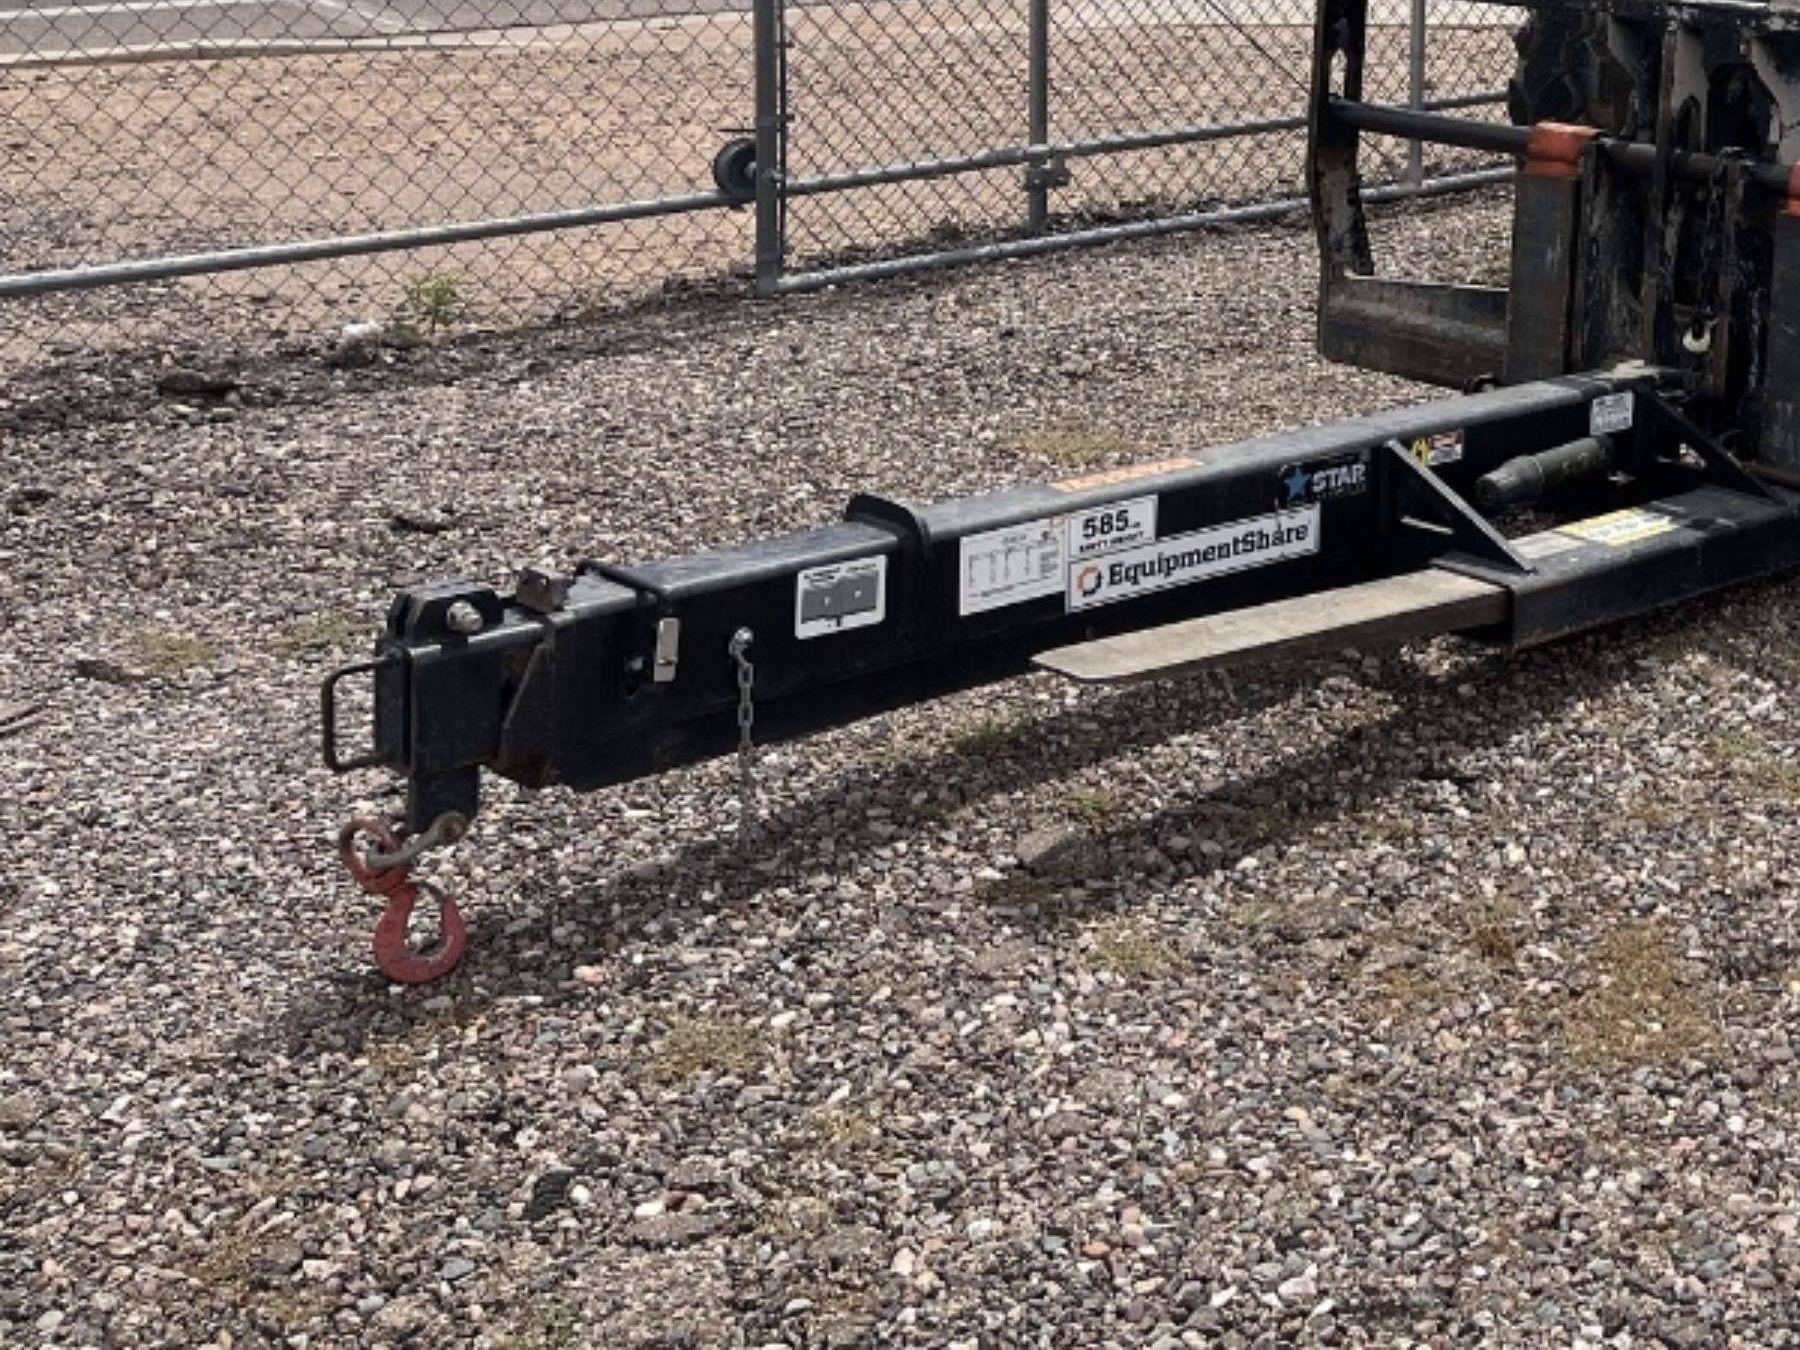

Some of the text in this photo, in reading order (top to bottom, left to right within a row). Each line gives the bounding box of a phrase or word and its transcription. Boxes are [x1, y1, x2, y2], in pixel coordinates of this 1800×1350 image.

[1311, 464, 1366, 492] STAR
[1082, 509, 1129, 539] 585
[1107, 523, 1310, 586] EquipmentShare
